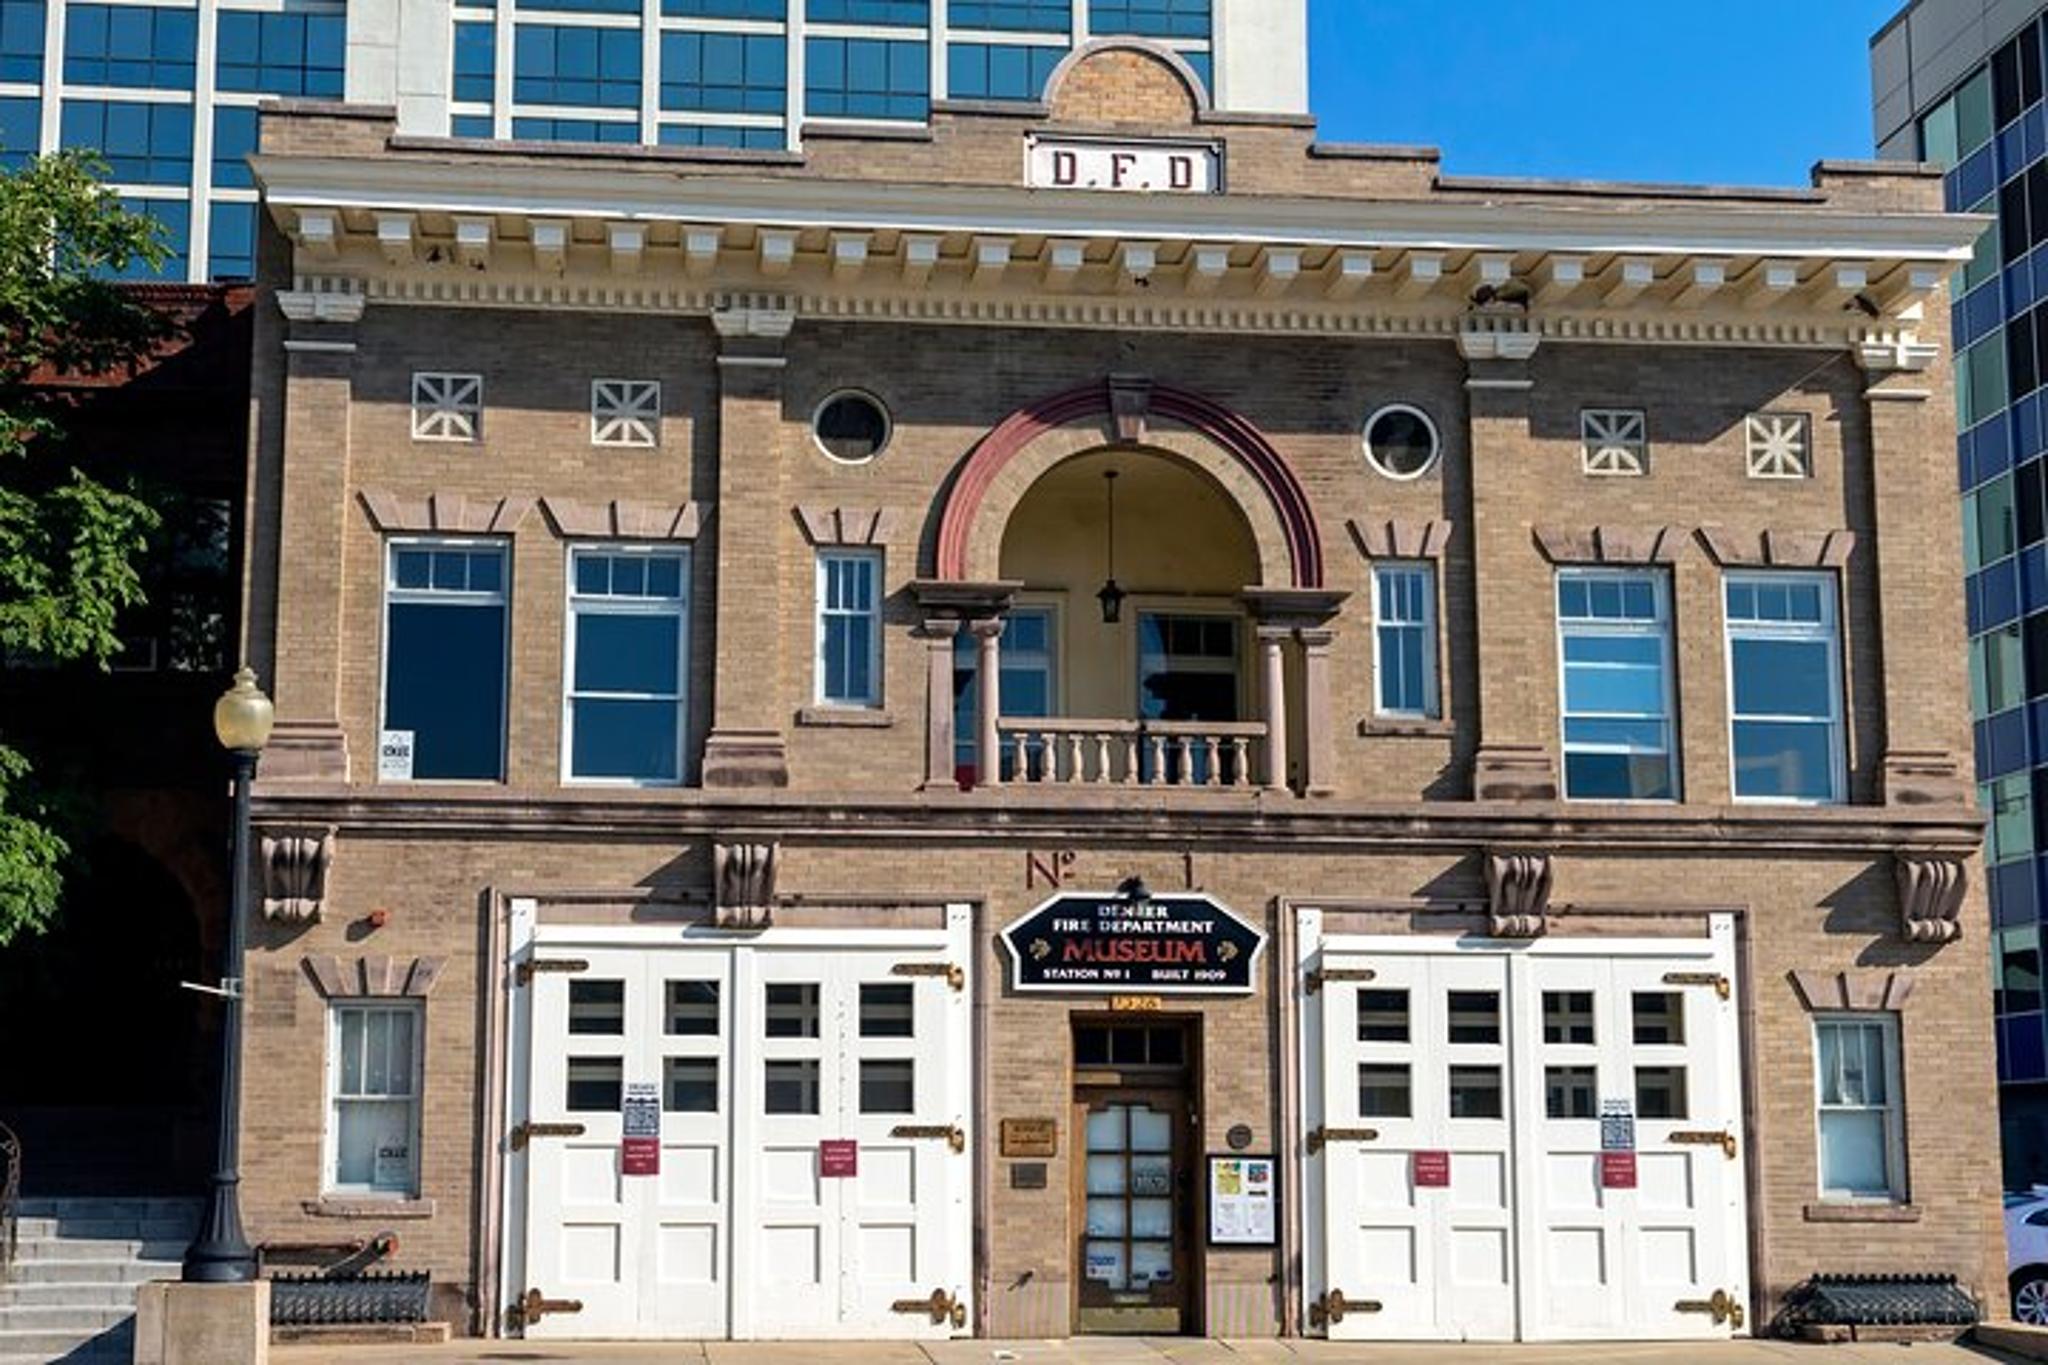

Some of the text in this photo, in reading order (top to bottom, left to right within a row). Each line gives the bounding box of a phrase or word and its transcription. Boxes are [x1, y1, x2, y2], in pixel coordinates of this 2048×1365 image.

[1053, 919, 1215, 933] FIRE DEPARTMENT
[1063, 939, 1207, 962] MUSEUM
[1043, 969, 1099, 979] STATION
[1151, 969, 1190, 980] BUILT
